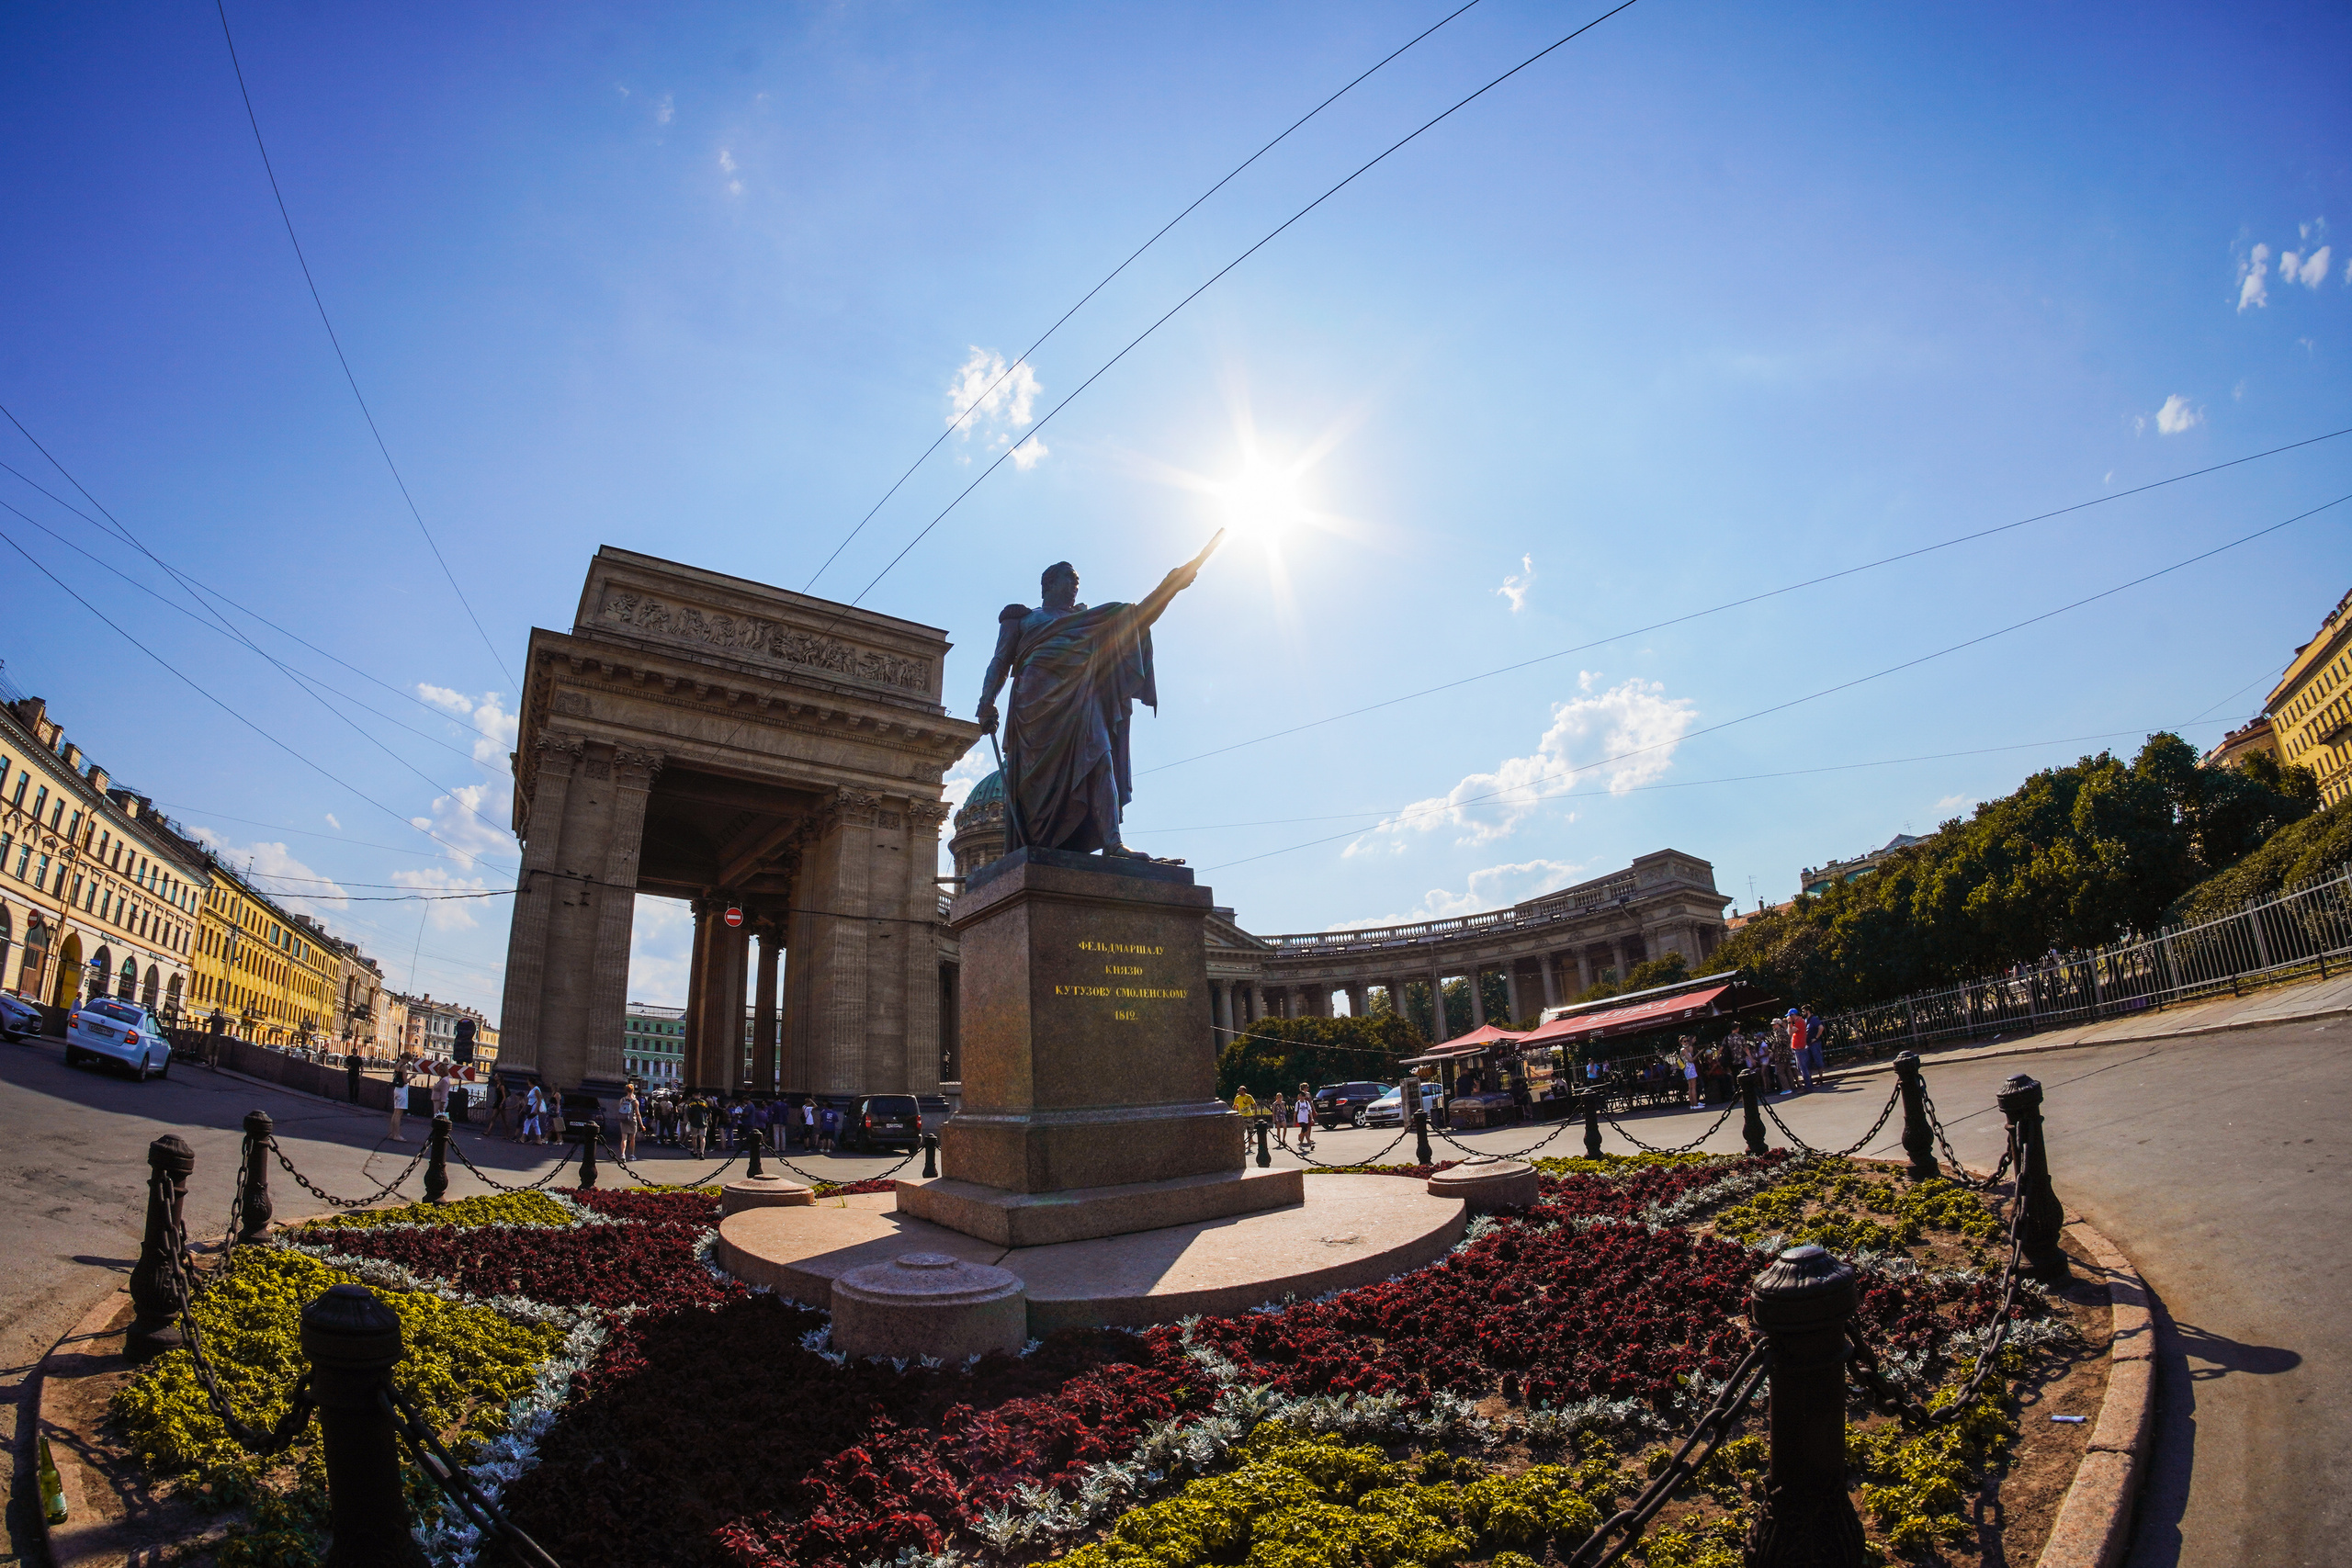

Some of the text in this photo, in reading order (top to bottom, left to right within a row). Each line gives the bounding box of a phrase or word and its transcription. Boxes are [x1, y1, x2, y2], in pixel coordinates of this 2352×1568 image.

[1078, 941, 1165, 955] ФЕЛЬДМАРШАЛУ
[1105, 964, 1143, 976] КНЯЗЮ
[1055, 985, 1189, 998] КУТУЗОВУ СМОЛЕНСКОМУ
